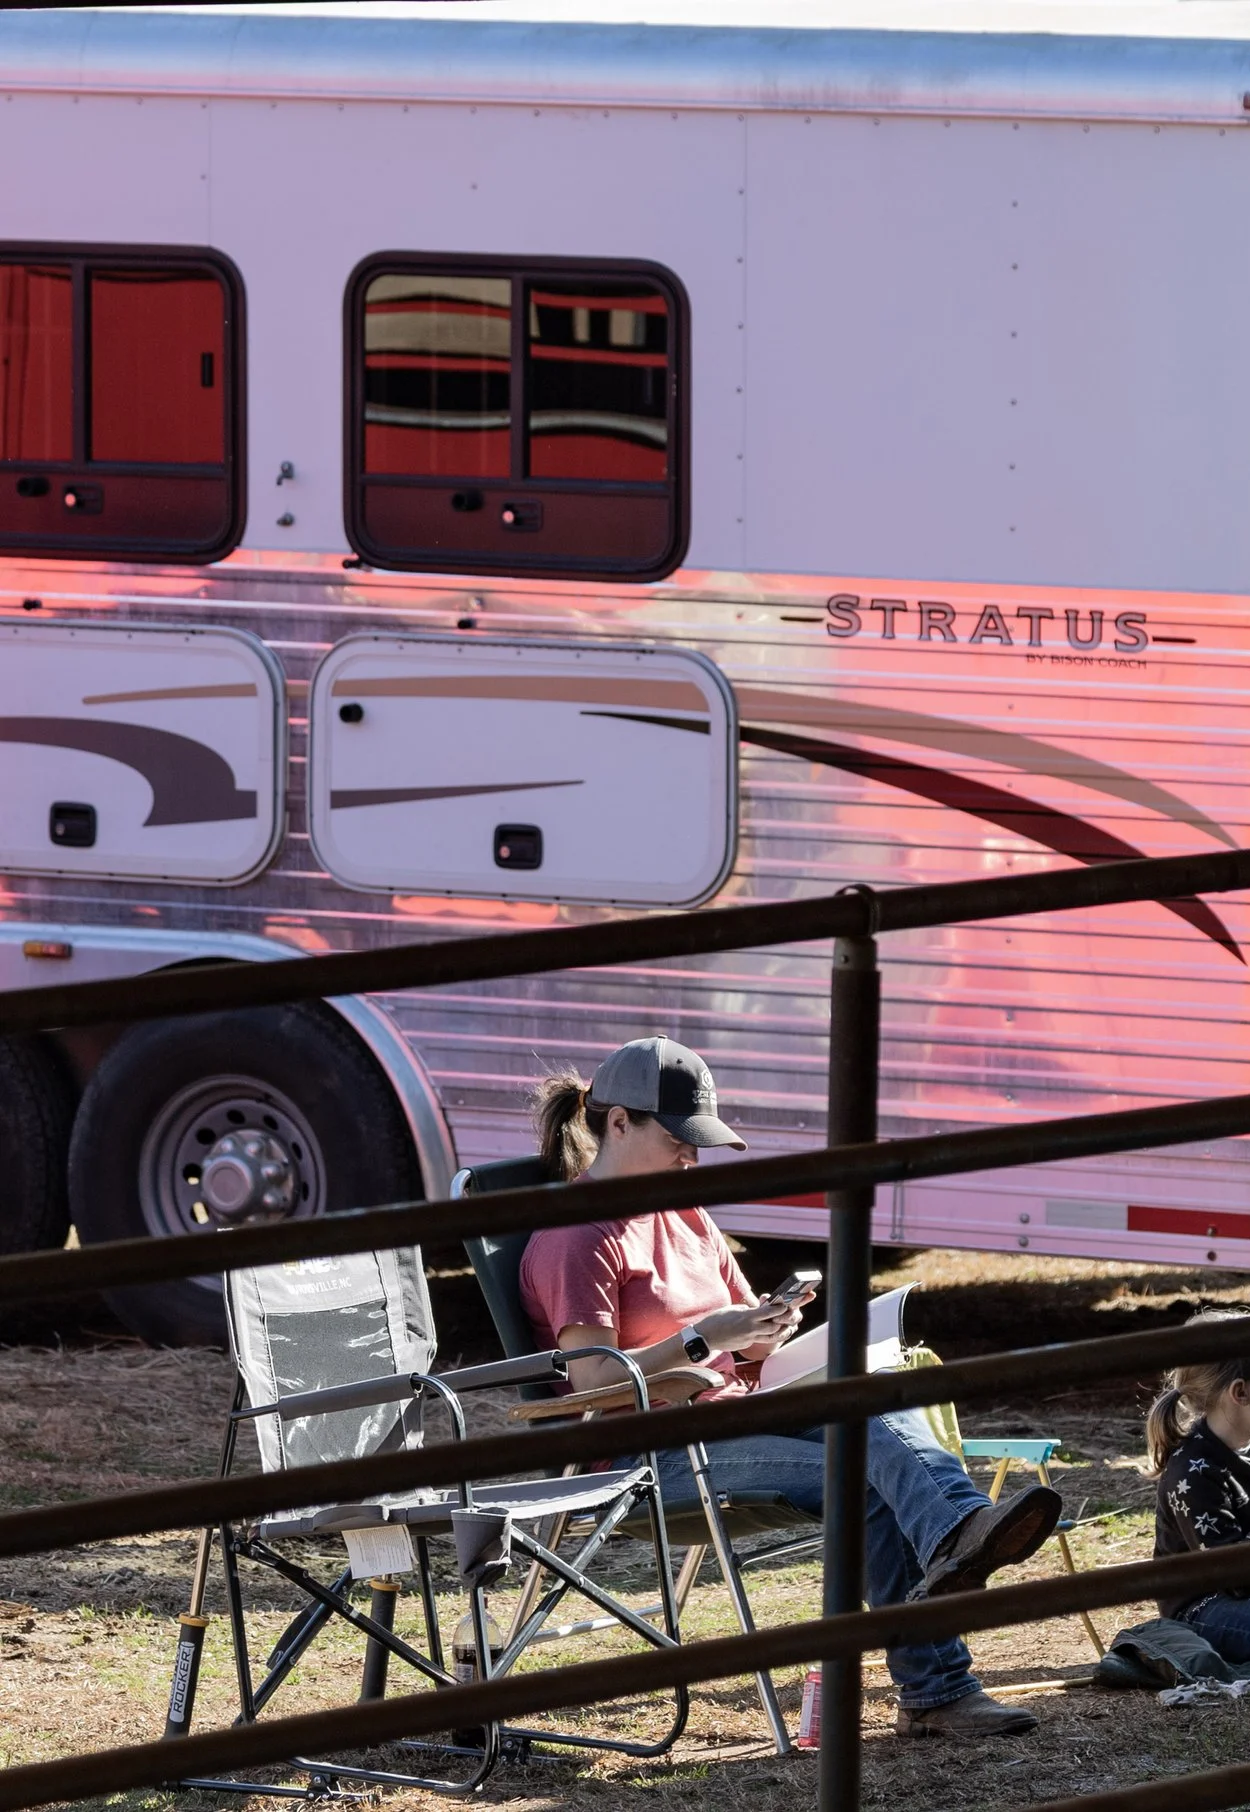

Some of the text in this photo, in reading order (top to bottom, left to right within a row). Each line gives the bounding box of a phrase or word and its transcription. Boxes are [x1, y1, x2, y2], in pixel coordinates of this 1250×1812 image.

[826, 593, 1149, 653] STRATUS
[1026, 654, 1148, 669] BY BISON COACH
[173, 1650, 191, 1713] ROCKER
